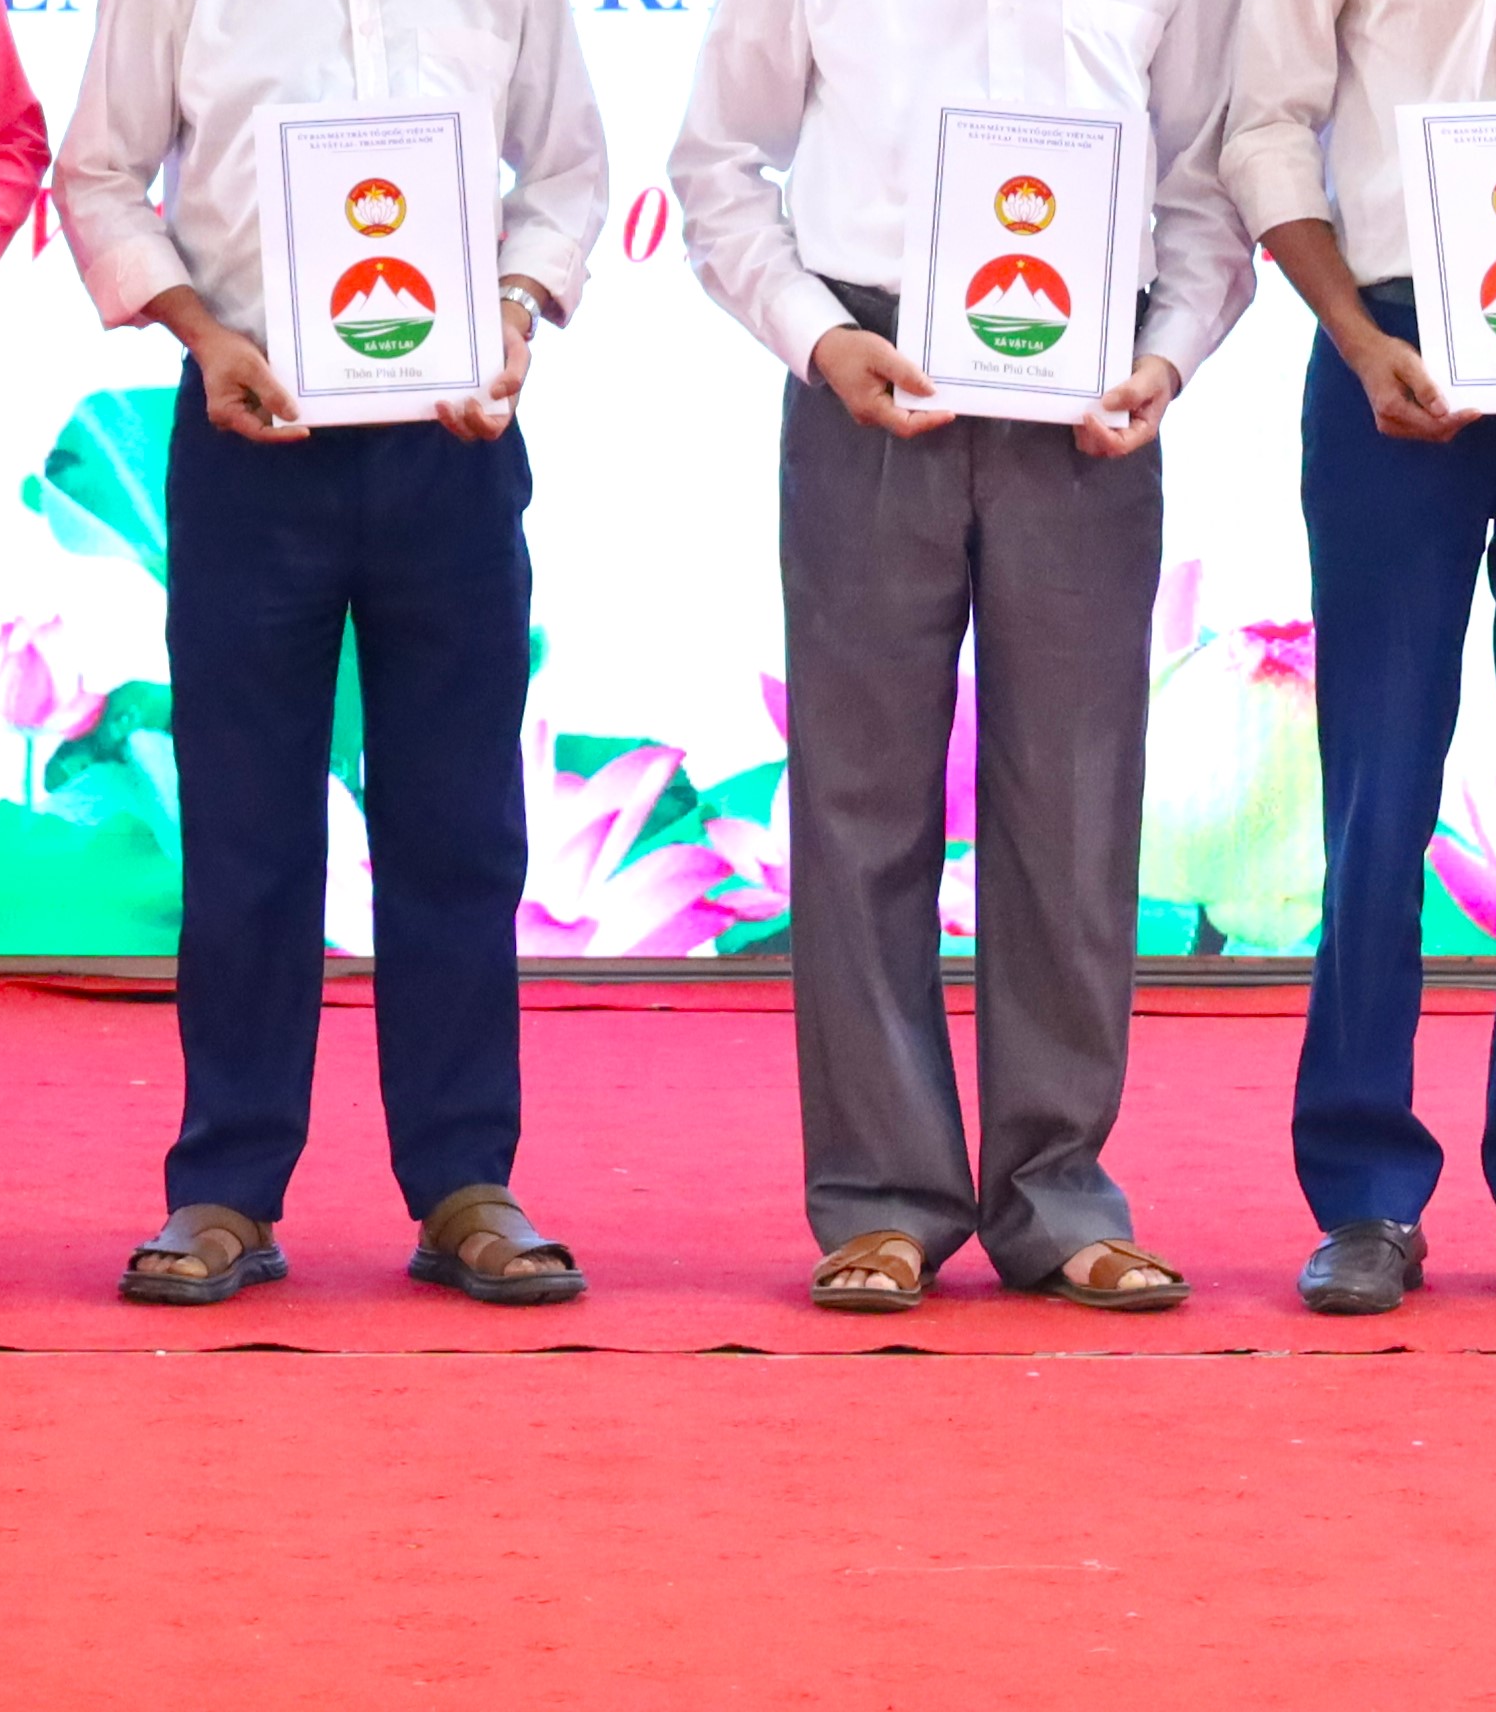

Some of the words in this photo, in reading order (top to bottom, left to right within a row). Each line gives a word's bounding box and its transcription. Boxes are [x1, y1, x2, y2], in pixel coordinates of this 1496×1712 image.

[363, 339, 378, 352] XÃ
[398, 339, 415, 351] LẠI
[994, 335, 1007, 348] XÃ
[1027, 339, 1044, 352] LẠI
